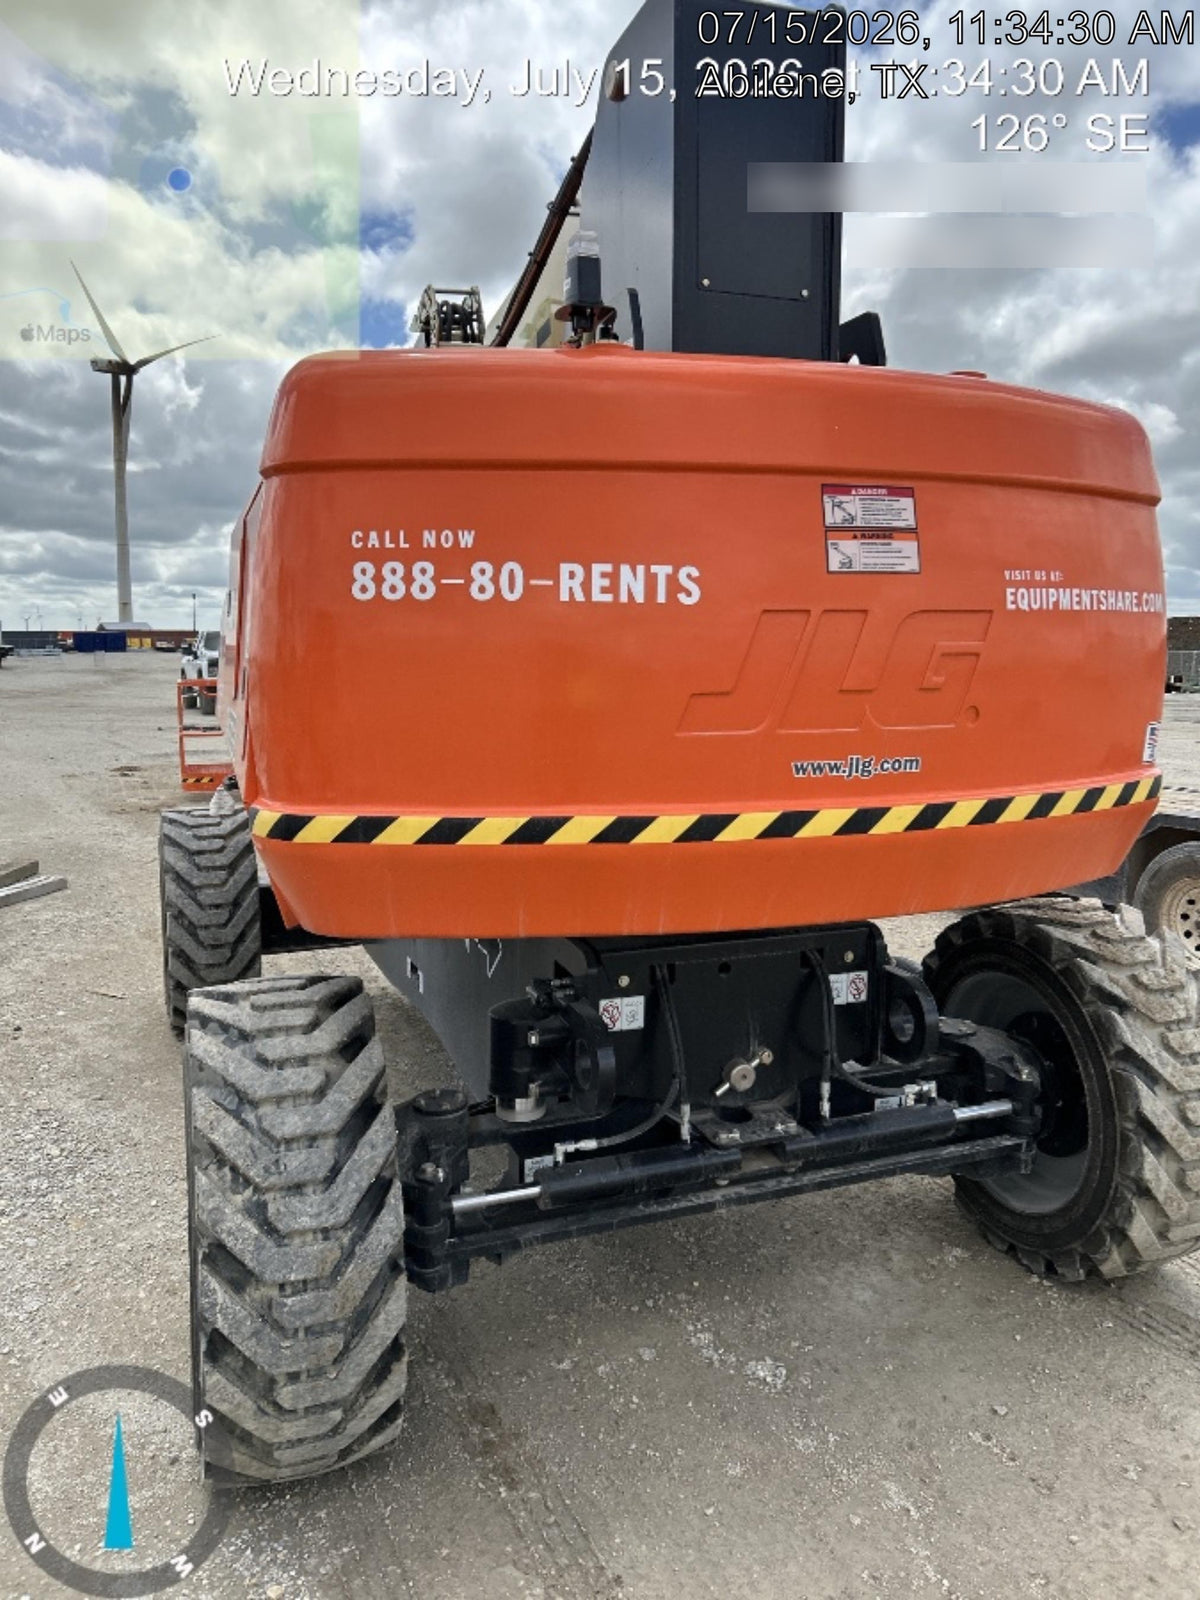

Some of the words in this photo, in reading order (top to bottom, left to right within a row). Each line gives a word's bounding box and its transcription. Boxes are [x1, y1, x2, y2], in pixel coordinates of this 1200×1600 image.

[351, 530, 410, 549] CALL
[422, 530, 476, 549] NOW
[351, 560, 702, 606] 888-80-RENTS
[1004, 570, 1031, 581] VISIT
[1035, 570, 1047, 581] US
[1005, 586, 1164, 613] EQUIPMENTSHARE.COM
[791, 755, 921, 779] www.jlg.com
